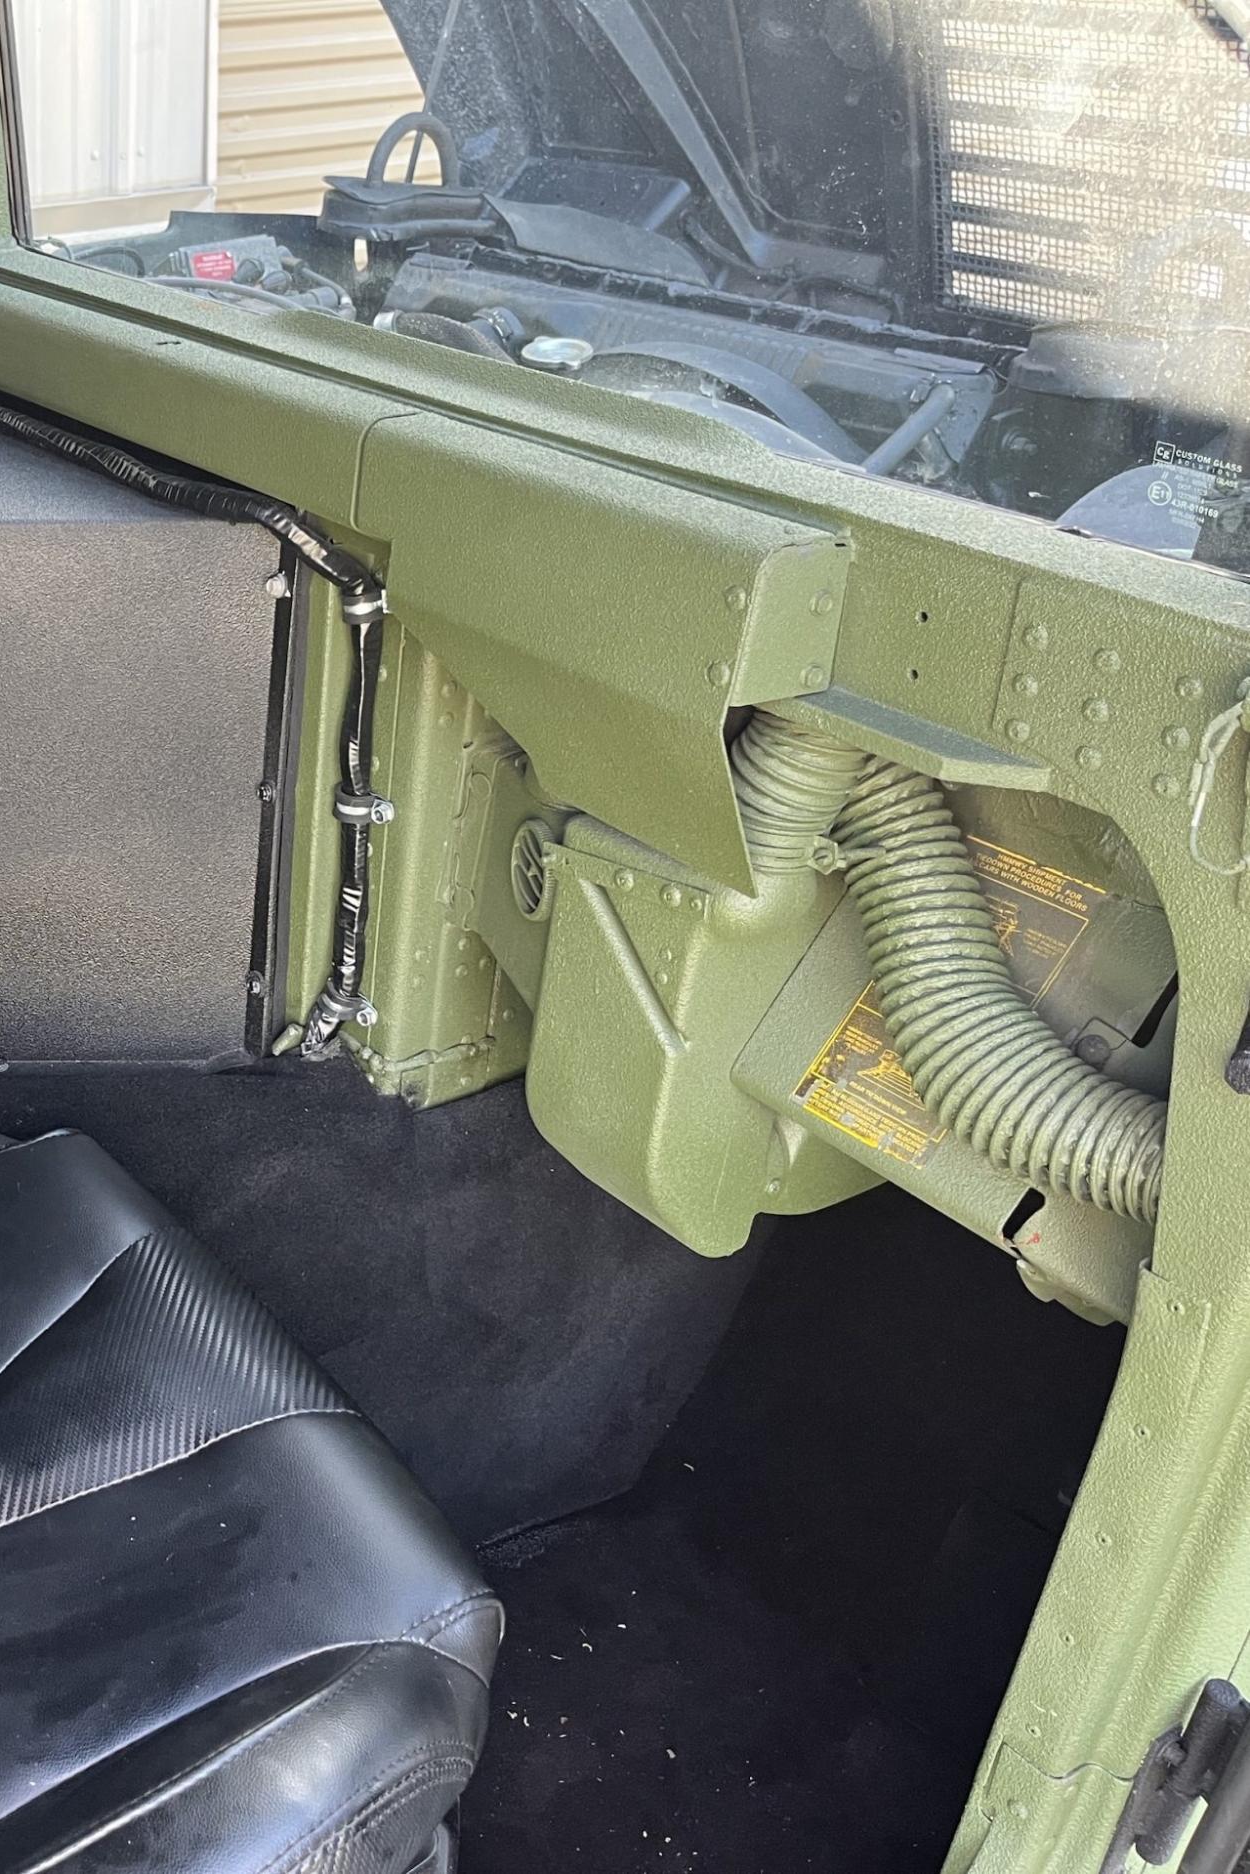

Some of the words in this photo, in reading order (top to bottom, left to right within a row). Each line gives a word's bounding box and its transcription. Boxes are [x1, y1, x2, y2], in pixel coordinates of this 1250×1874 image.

[1175, 449, 1211, 464] CUSTOM
[1213, 459, 1243, 473] GLASS
[978, 862, 999, 873] CARS
[1000, 871, 1020, 883] WITH
[1021, 879, 1055, 897] WOODEN
[1054, 894, 1087, 912] FLOORS
[1010, 866, 1062, 893] PROCEDURES
[1064, 889, 1082, 900] FOR
[1028, 865, 1067, 886] SHIPMENT
